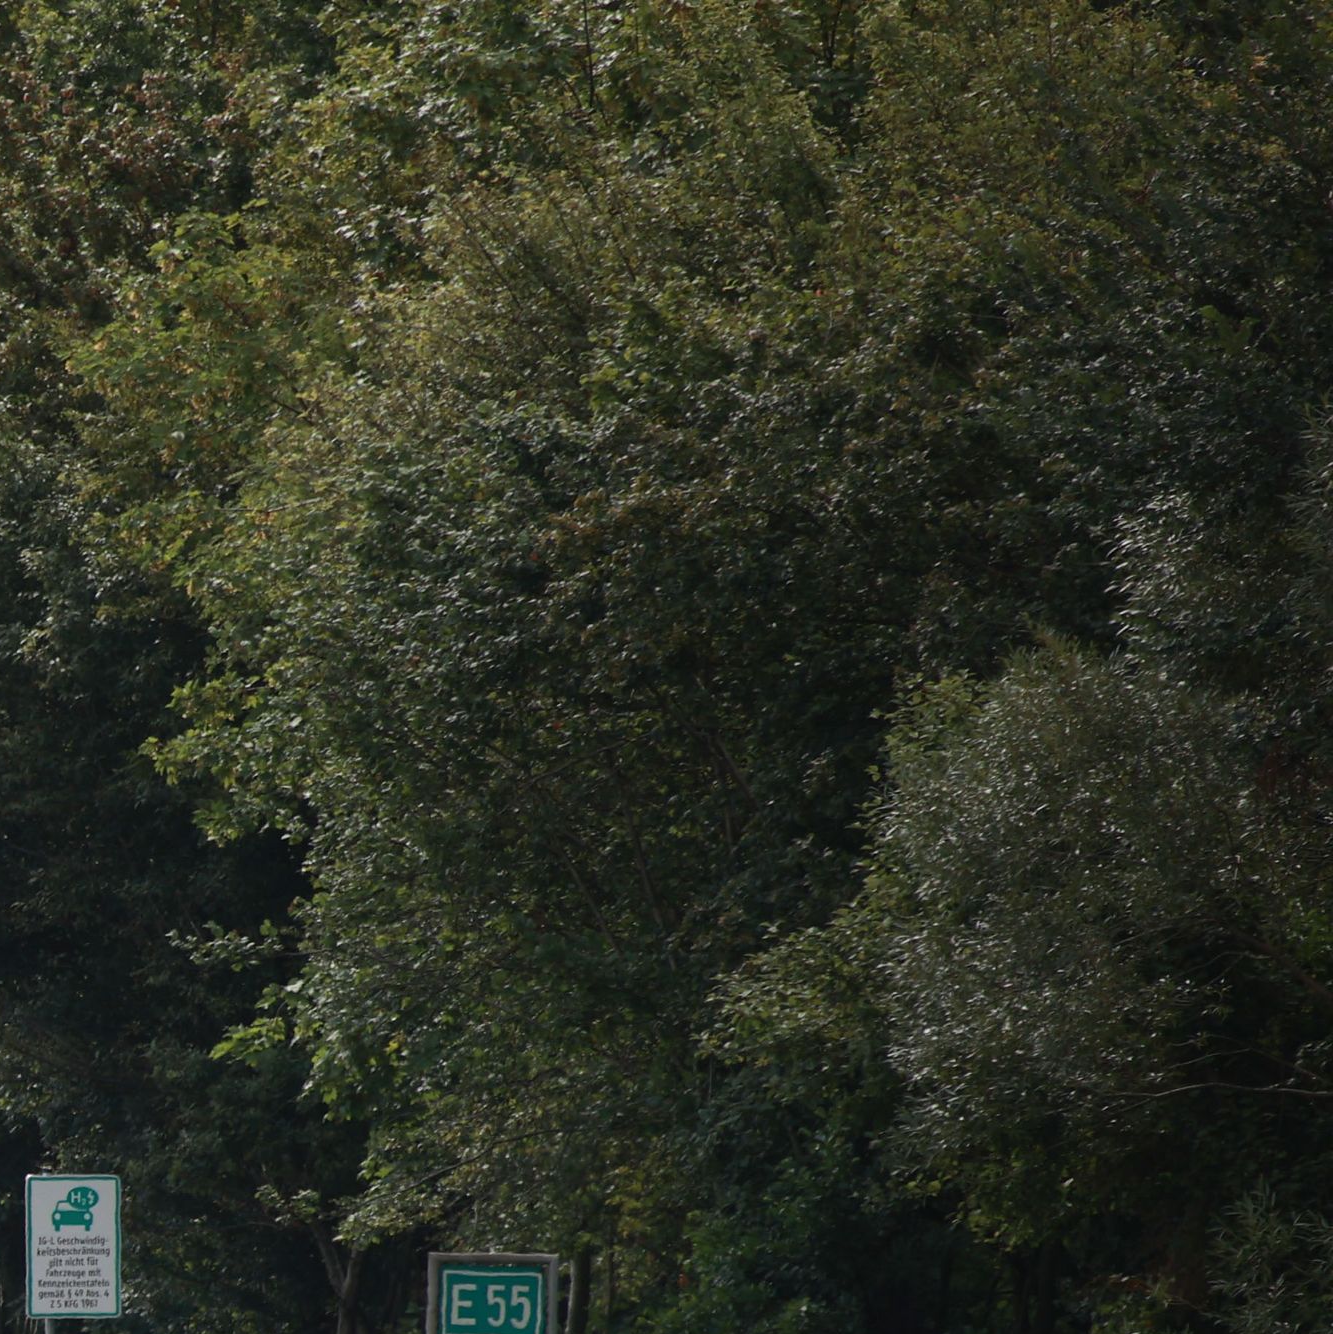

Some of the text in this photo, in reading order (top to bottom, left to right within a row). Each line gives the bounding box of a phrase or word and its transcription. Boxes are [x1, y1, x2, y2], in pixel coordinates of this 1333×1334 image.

[65, 1257, 85, 1266] nicht
[46, 1268, 86, 1279] Fahrzeuge
[451, 1284, 531, 1329] E 55
